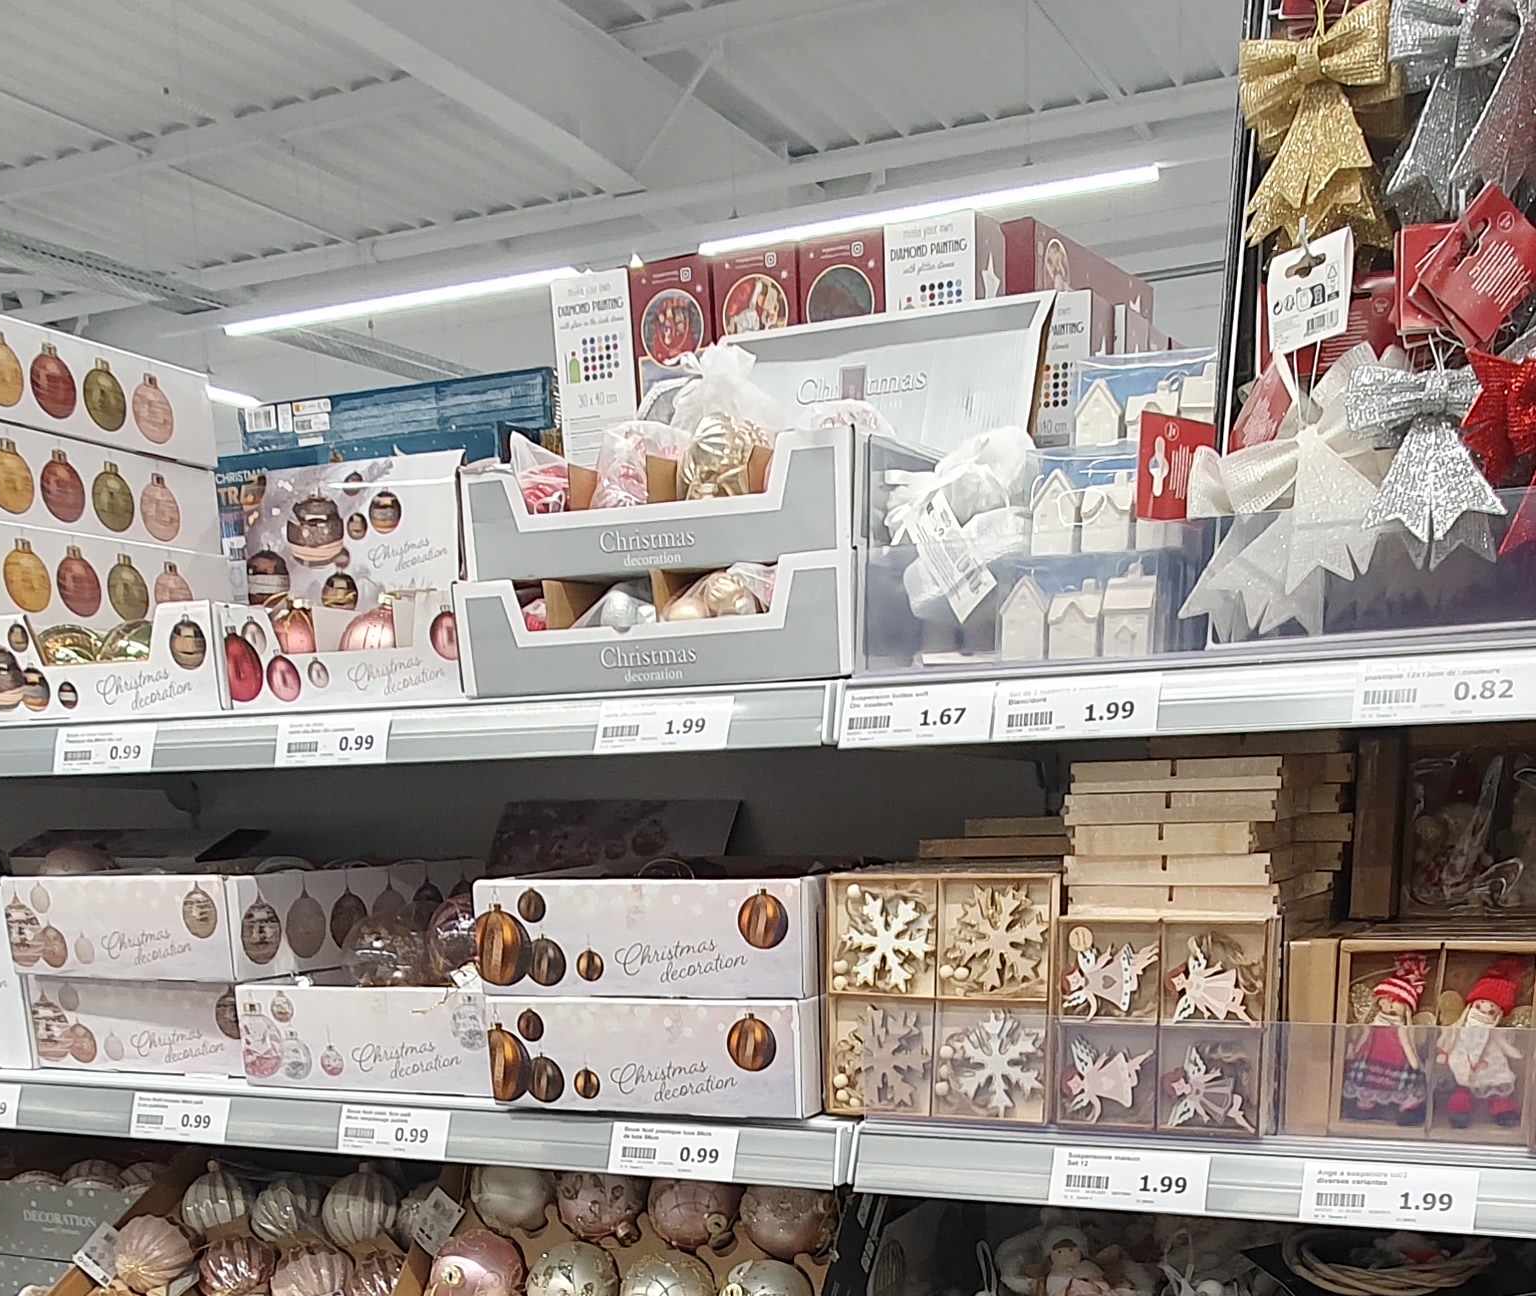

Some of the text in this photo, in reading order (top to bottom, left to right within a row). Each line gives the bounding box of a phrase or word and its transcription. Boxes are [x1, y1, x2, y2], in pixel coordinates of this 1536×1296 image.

[890, 238, 967, 261] DIAMOND PAINTING
[558, 297, 624, 318] DIAMOND PAINTING
[368, 538, 430, 569] Christmas
[599, 528, 696, 555] Christmas
[394, 546, 448, 572] decoration
[623, 552, 682, 568] decoration
[599, 645, 697, 669] Christmas
[347, 656, 422, 691] Christmas
[384, 667, 446, 696] decoration
[623, 667, 683, 683] decoration
[96, 668, 170, 706] Christmas
[131, 681, 193, 711] decoration
[1454, 679, 1514, 701] 0.82
[918, 707, 967, 727] 1.67
[1084, 701, 1135, 722] 1.99
[664, 717, 706, 736] 1.99
[109, 744, 141, 760] 0.99
[338, 734, 374, 751] 0.99
[101, 928, 171, 960] Christmas
[134, 941, 192, 967] decoration
[614, 938, 718, 977] Christmas
[660, 953, 748, 983] decoration
[130, 1028, 204, 1058] Christmas
[164, 1039, 226, 1064] decoration
[352, 1041, 437, 1073] Christmas
[390, 1054, 462, 1081] decoration
[610, 1060, 708, 1095] Christmas
[653, 1074, 738, 1103] decoration
[180, 1113, 211, 1129] 0.99
[394, 1127, 429, 1144] 0.99
[679, 1146, 719, 1164] 0.99
[1138, 1174, 1188, 1195] 1.99
[1398, 1191, 1453, 1213] 1.99
[23, 1208, 97, 1228] DECORATION
